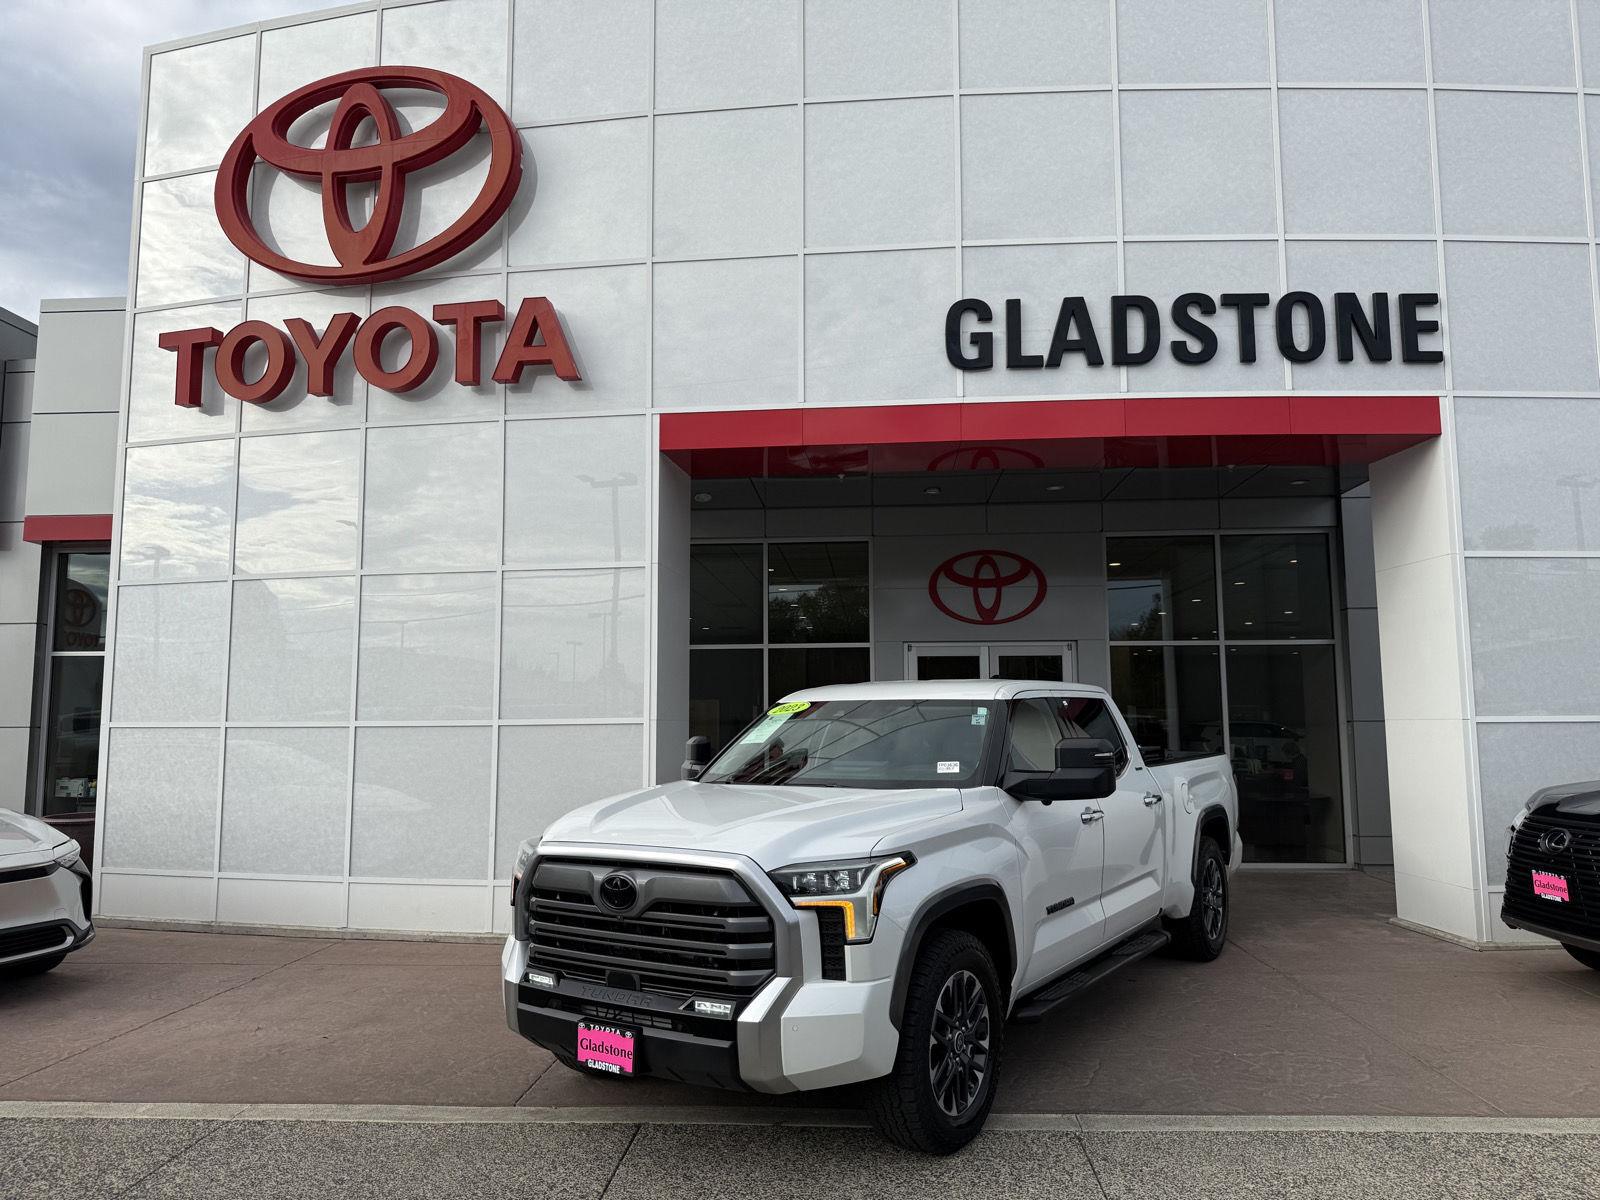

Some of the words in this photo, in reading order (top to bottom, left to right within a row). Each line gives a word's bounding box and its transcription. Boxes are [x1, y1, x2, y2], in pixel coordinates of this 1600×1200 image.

[945, 291, 1444, 371] GLADSTONE
[158, 296, 582, 409] TOYOTA
[1534, 879, 1568, 894] Gladstone
[589, 1024, 621, 1036] TOYOTA
[580, 1038, 633, 1060] Gladstone
[587, 1059, 620, 1074] GLADSTONE
